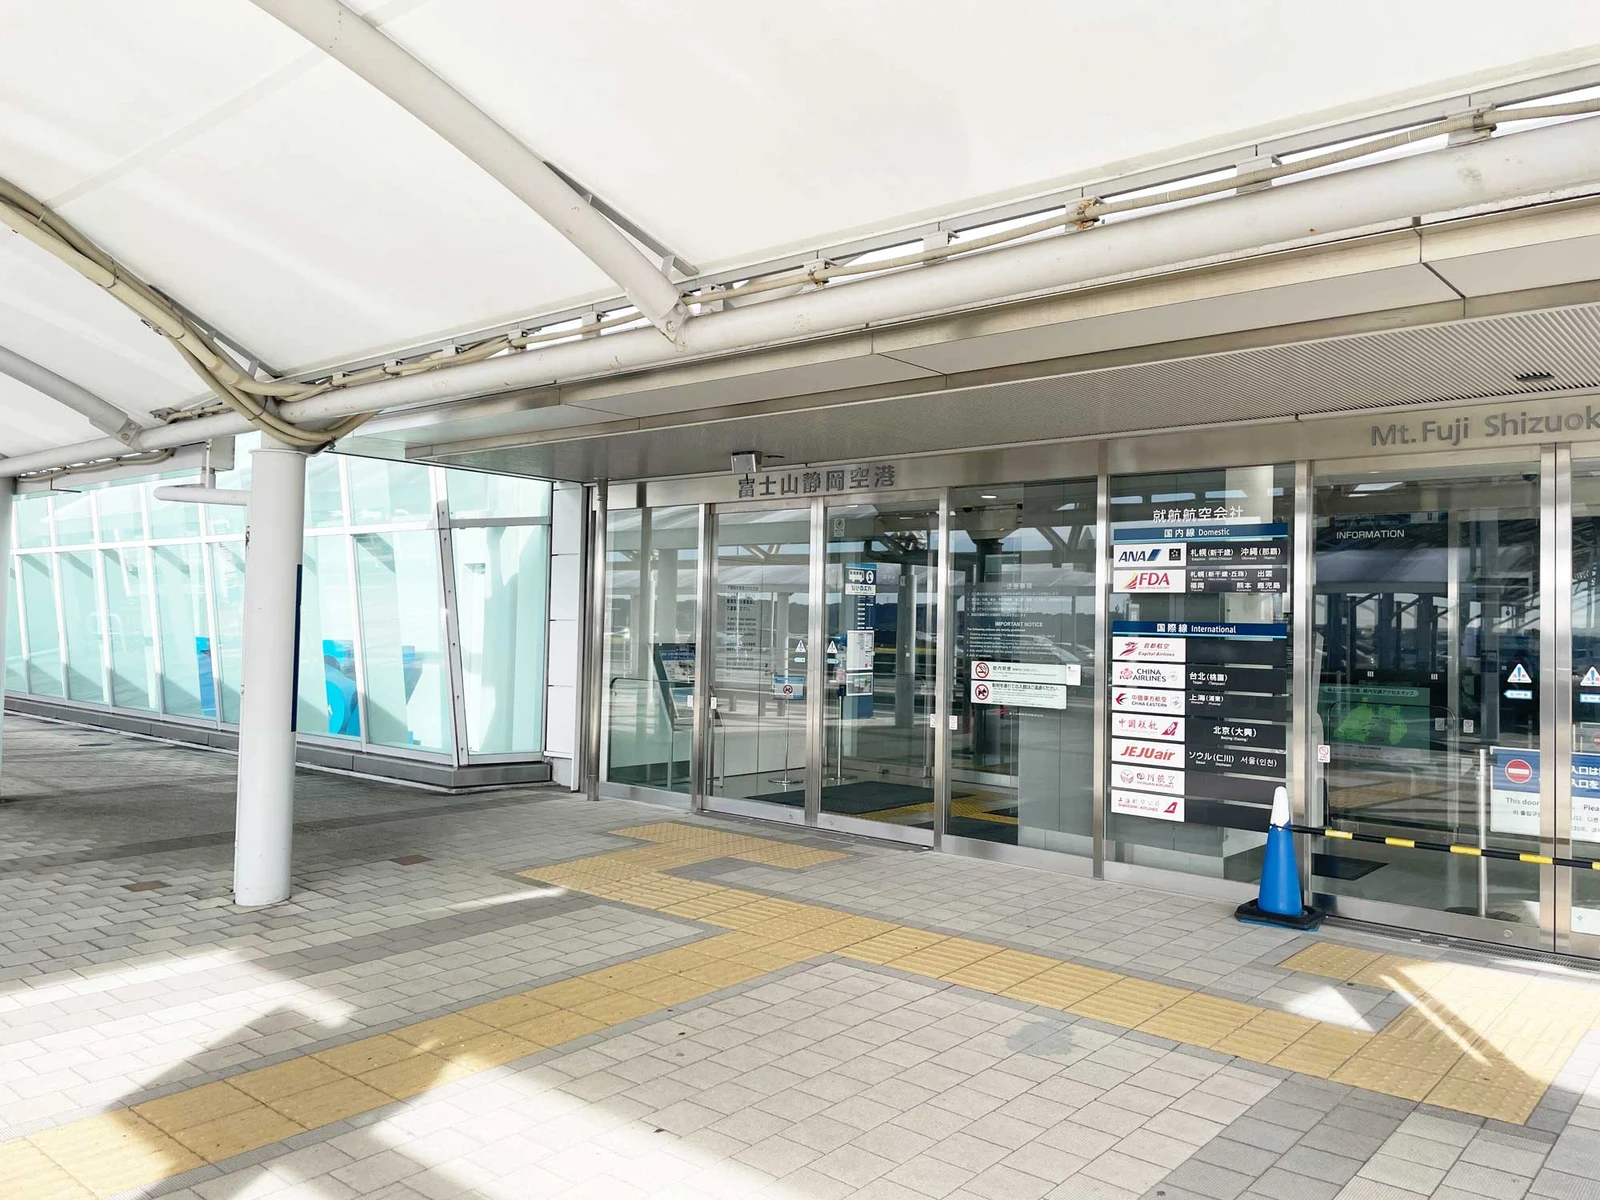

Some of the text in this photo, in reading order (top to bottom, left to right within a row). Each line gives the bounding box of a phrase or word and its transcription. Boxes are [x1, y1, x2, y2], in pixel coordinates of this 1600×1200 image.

[1371, 424, 1416, 446] Mt.
[1422, 417, 1469, 446] Fuji
[738, 465, 895, 498] 富士山静岡空港
[1152, 506, 1244, 524] 就航航空会社
[1164, 528, 1230, 538] 国内線 Domestic
[1336, 529, 1405, 540] INFORMATION
[1119, 551, 1146, 562] ANA
[1139, 572, 1170, 586] FDA
[1157, 623, 1237, 634] 国際線 International
[1213, 726, 1257, 738] 北京(大興)
[1189, 751, 1278, 768] ソウル(仁川) 서울(인천)
[1506, 797, 1539, 806] This door
